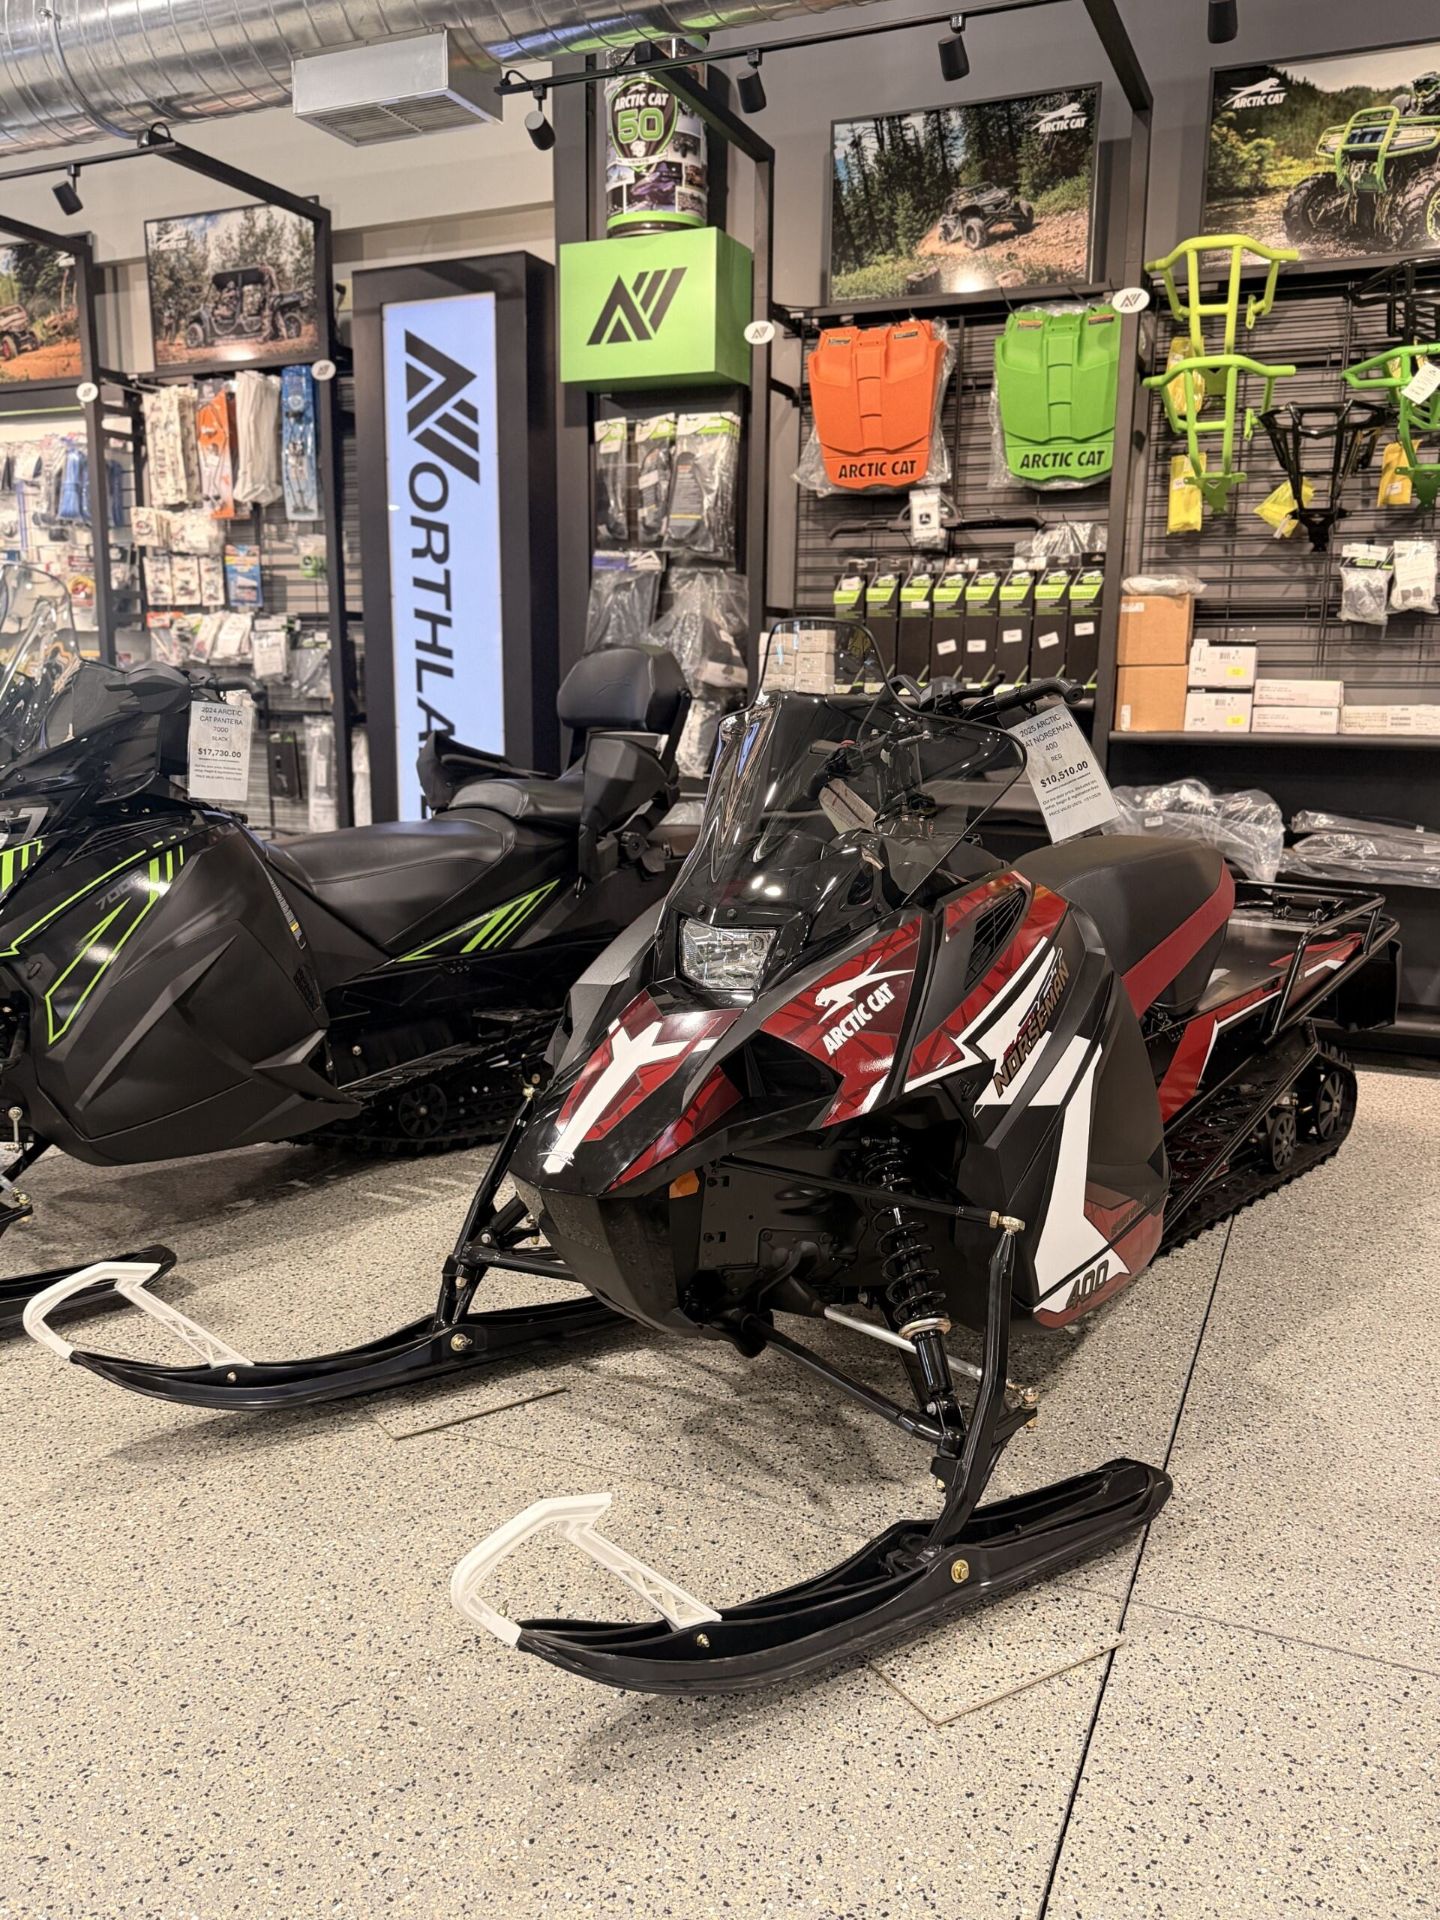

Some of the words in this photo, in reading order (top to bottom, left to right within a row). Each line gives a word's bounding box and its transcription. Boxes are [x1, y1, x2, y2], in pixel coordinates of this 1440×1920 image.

[614, 93, 647, 112] ARCTIC
[648, 92, 669, 106] CAT
[1232, 94, 1267, 109] ARCTIC
[1267, 92, 1286, 106] CAT
[618, 107, 664, 144] 50
[1039, 118, 1069, 133] ARCTIC
[1069, 116, 1087, 130] CAT
[838, 462, 887, 479] ARCTIC
[891, 459, 917, 475] CAT
[1019, 452, 1073, 469] ARCTIC
[1077, 450, 1106, 466] CAT
[213, 717, 243, 725] PANTERA
[217, 708, 243, 716] ARCTIC
[1020, 725, 1037, 738] 2025
[1037, 713, 1062, 730] ARCTIC
[1032, 721, 1073, 744] NORSEMAN
[198, 748, 242, 758] $17,730.00
[1045, 742, 1059, 751] 400
[1040, 760, 1088, 788] $10,510.00
[821, 1000, 873, 1056] ARCTIC
[871, 982, 897, 1012] CAT
[992, 959, 1069, 1098] NORSEMAN
[1065, 1259, 1109, 1310] 400
